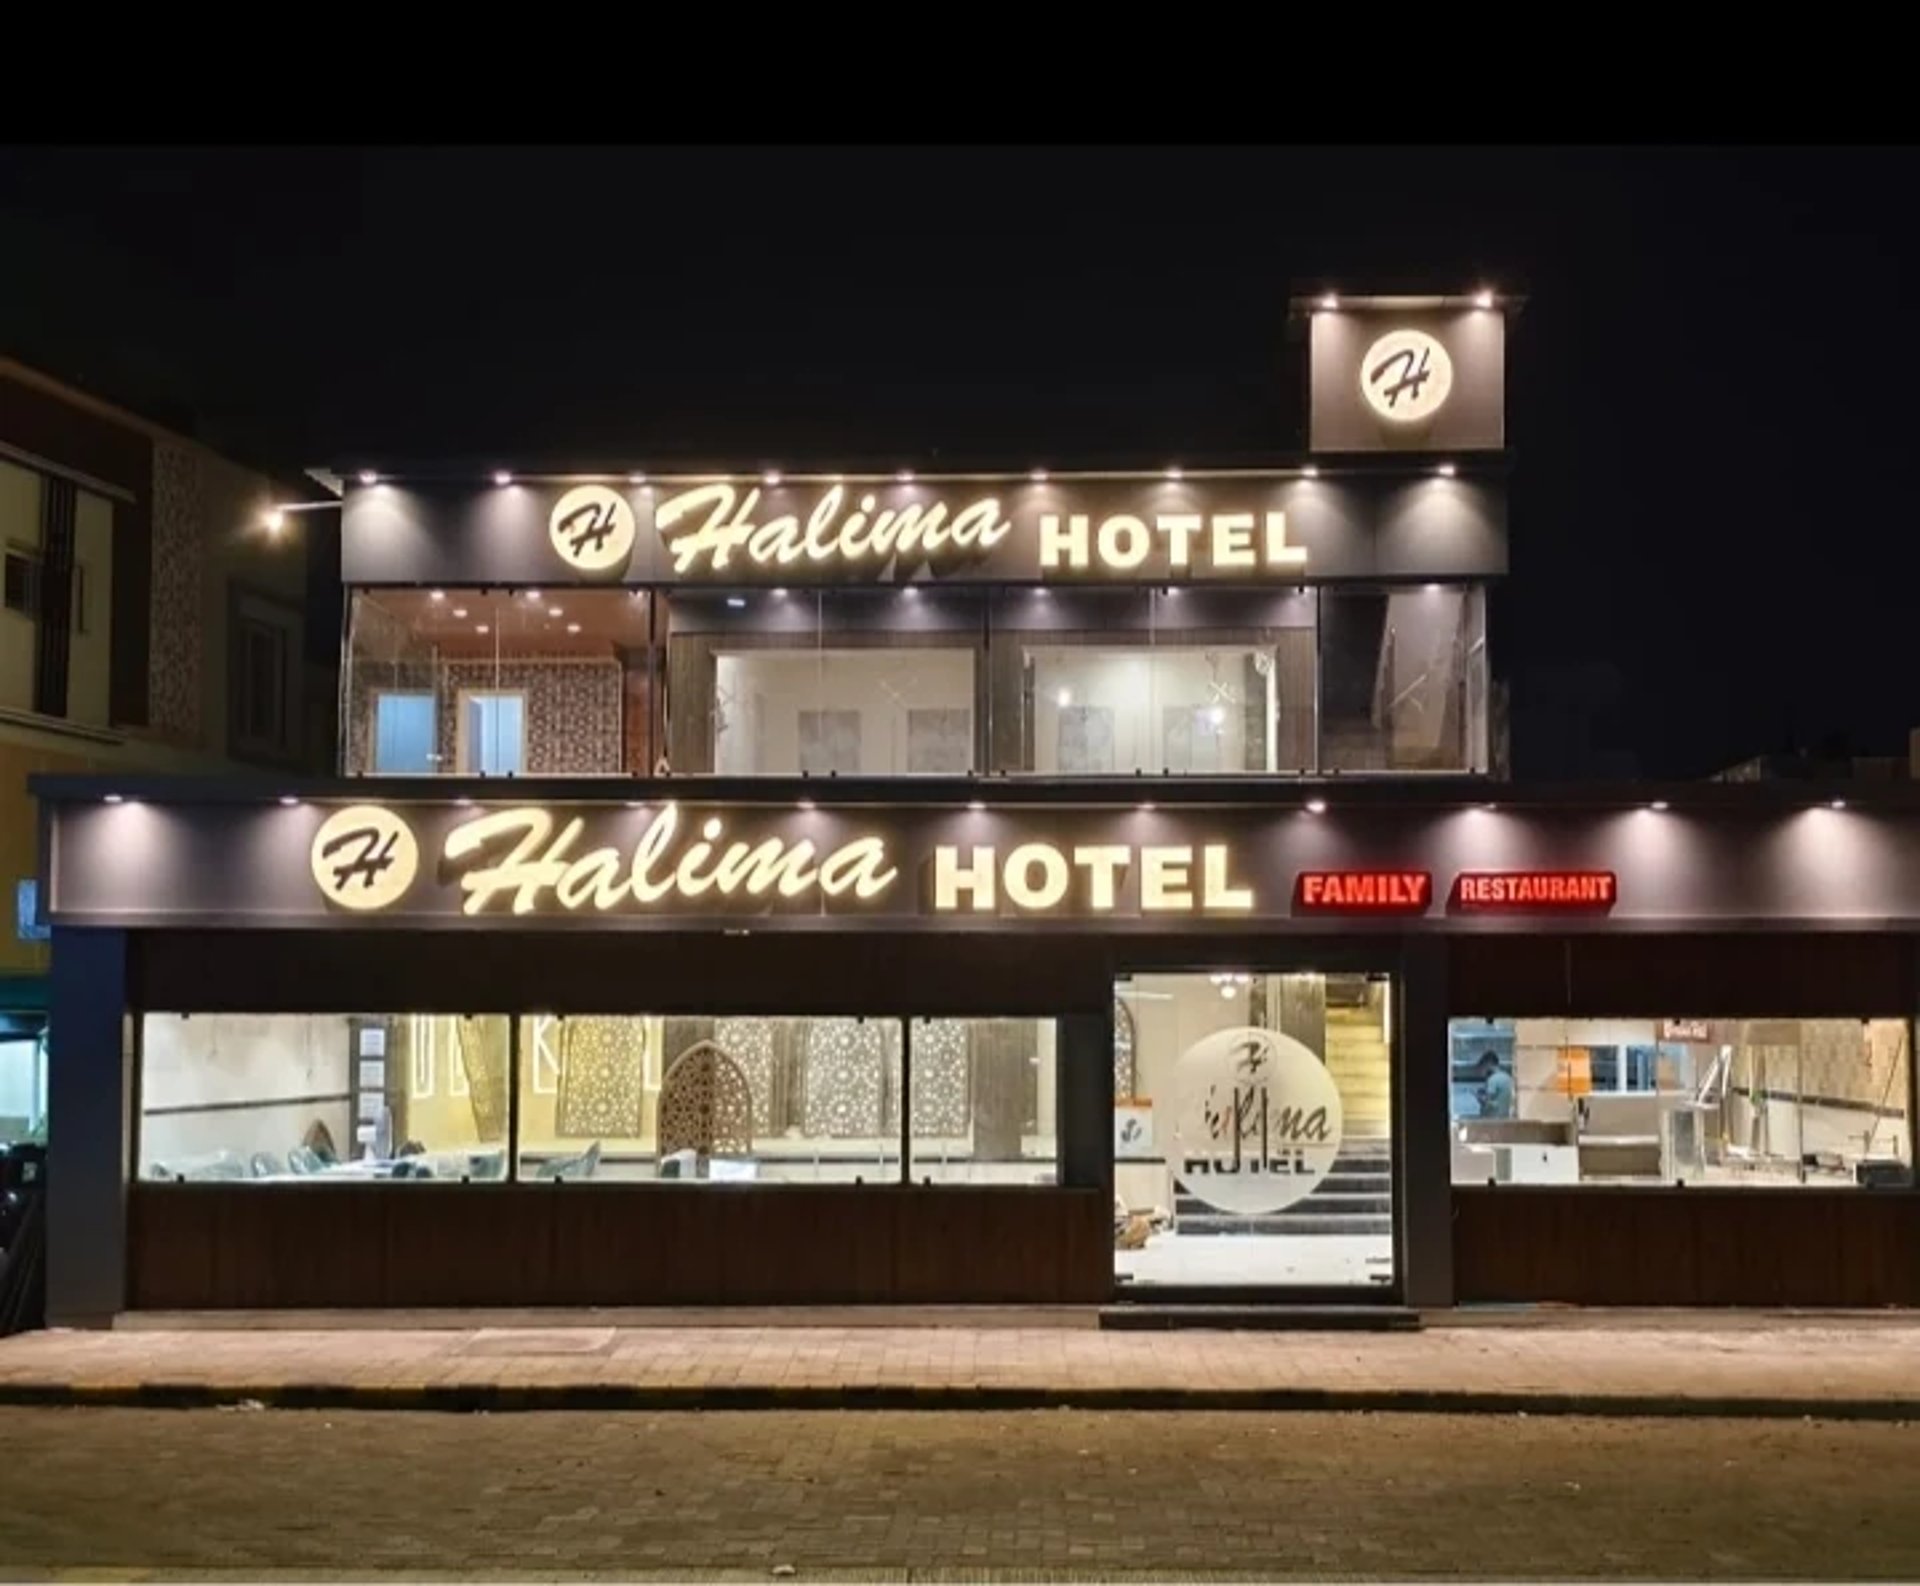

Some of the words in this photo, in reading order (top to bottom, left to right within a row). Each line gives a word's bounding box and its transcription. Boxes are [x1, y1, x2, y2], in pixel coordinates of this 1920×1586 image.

[1371, 346, 1430, 408] H
[558, 501, 616, 557] H
[655, 484, 1011, 573] Halima
[1039, 512, 1308, 569] HOTEL
[322, 826, 398, 892] H
[444, 800, 898, 916] Halima
[934, 843, 1254, 910] HOTEL
[1303, 875, 1426, 903] FAMILY
[1460, 876, 1612, 901] RESTAURANT
